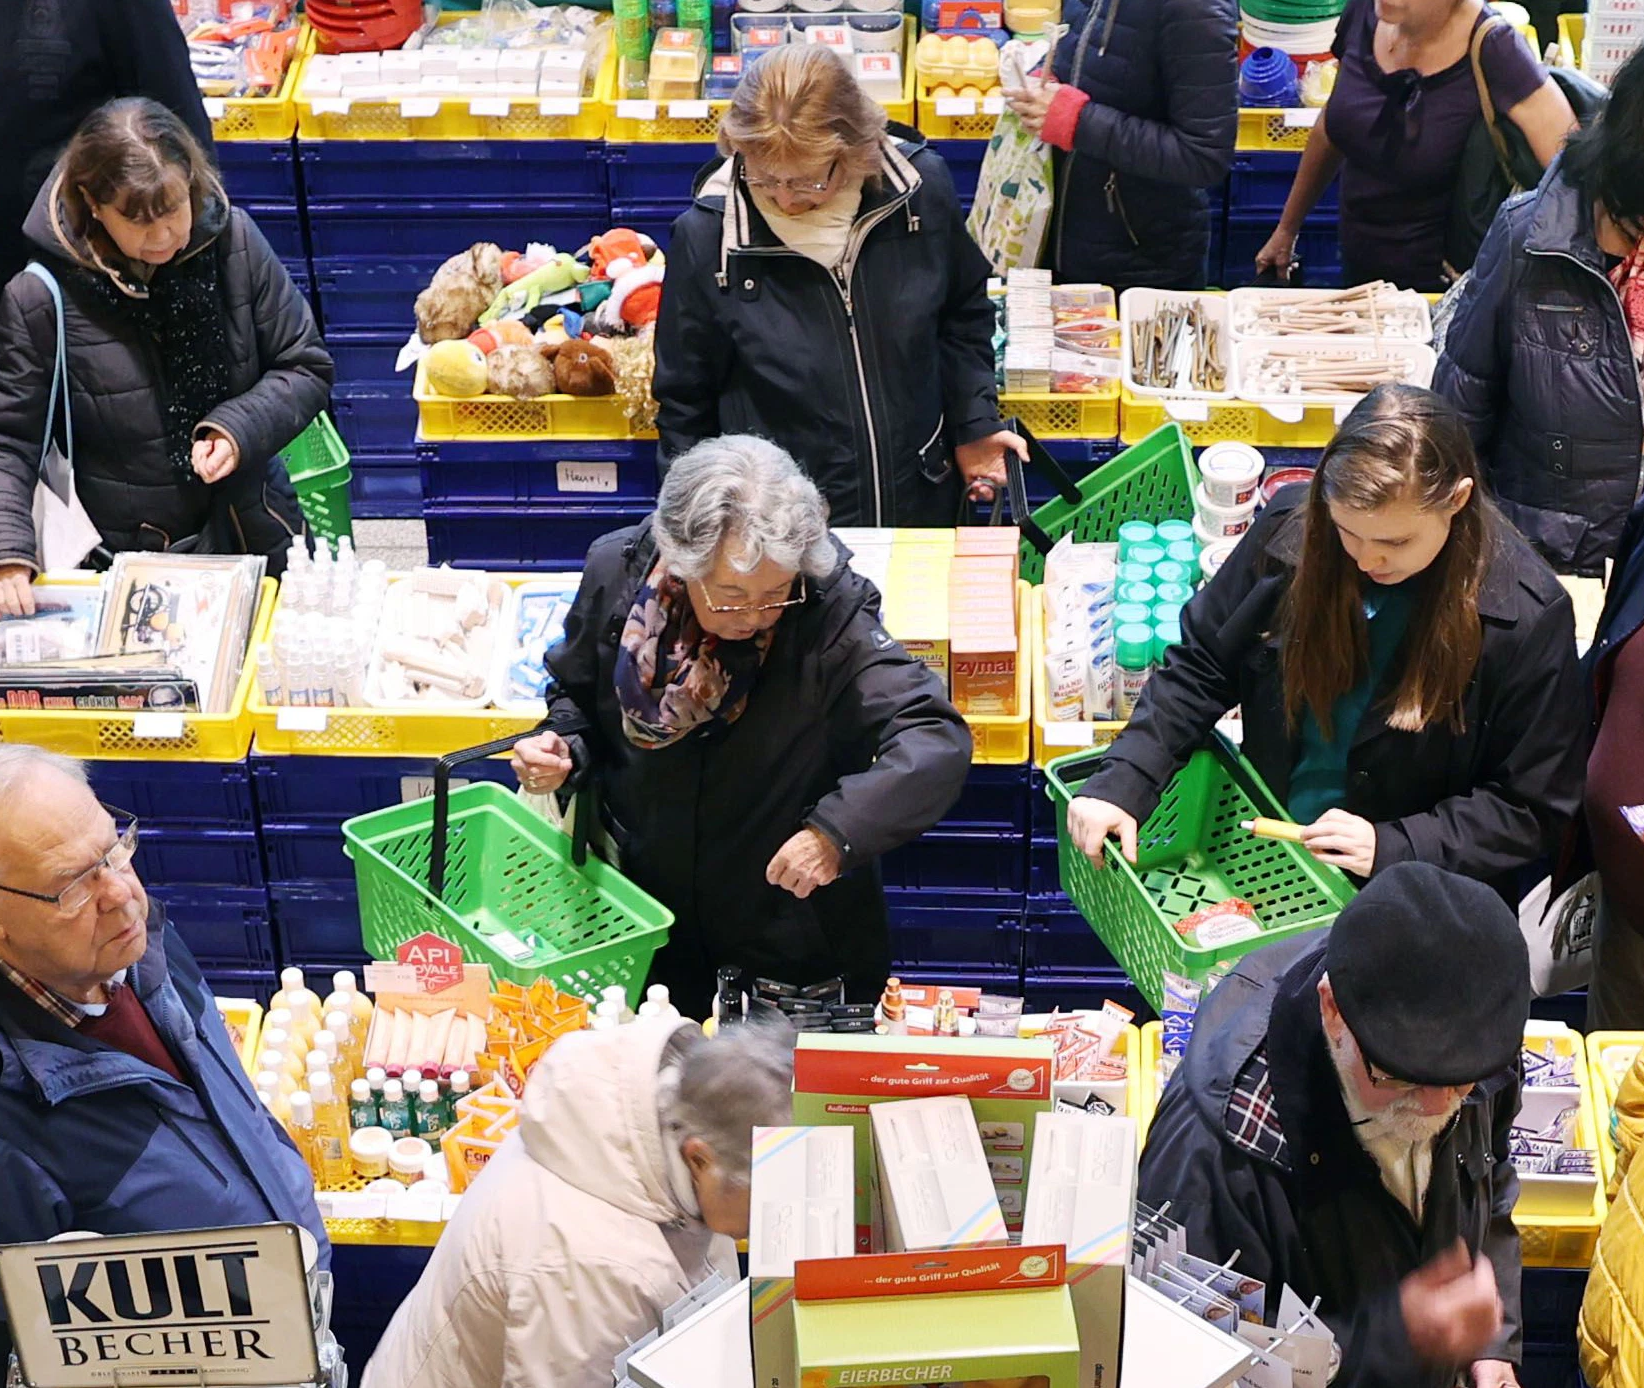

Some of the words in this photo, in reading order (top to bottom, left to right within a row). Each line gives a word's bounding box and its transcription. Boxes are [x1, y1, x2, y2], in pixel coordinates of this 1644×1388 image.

[955, 657, 1016, 679] zymat
[6, 689, 42, 710] DDR
[870, 1074, 888, 1085] der
[888, 1076, 911, 1087] gute
[911, 1075, 934, 1086] Griff
[935, 1077, 951, 1086] zur
[952, 1072, 991, 1089] Qualität
[875, 1274, 893, 1285] der
[894, 1274, 917, 1286] gute
[918, 1271, 942, 1283] Griff
[944, 1270, 960, 1280] zur
[961, 1261, 1001, 1277] Qualität
[37, 1250, 260, 1326] KULT
[54, 1328, 275, 1367] BECHER
[838, 1364, 953, 1385] EIERBECHER
